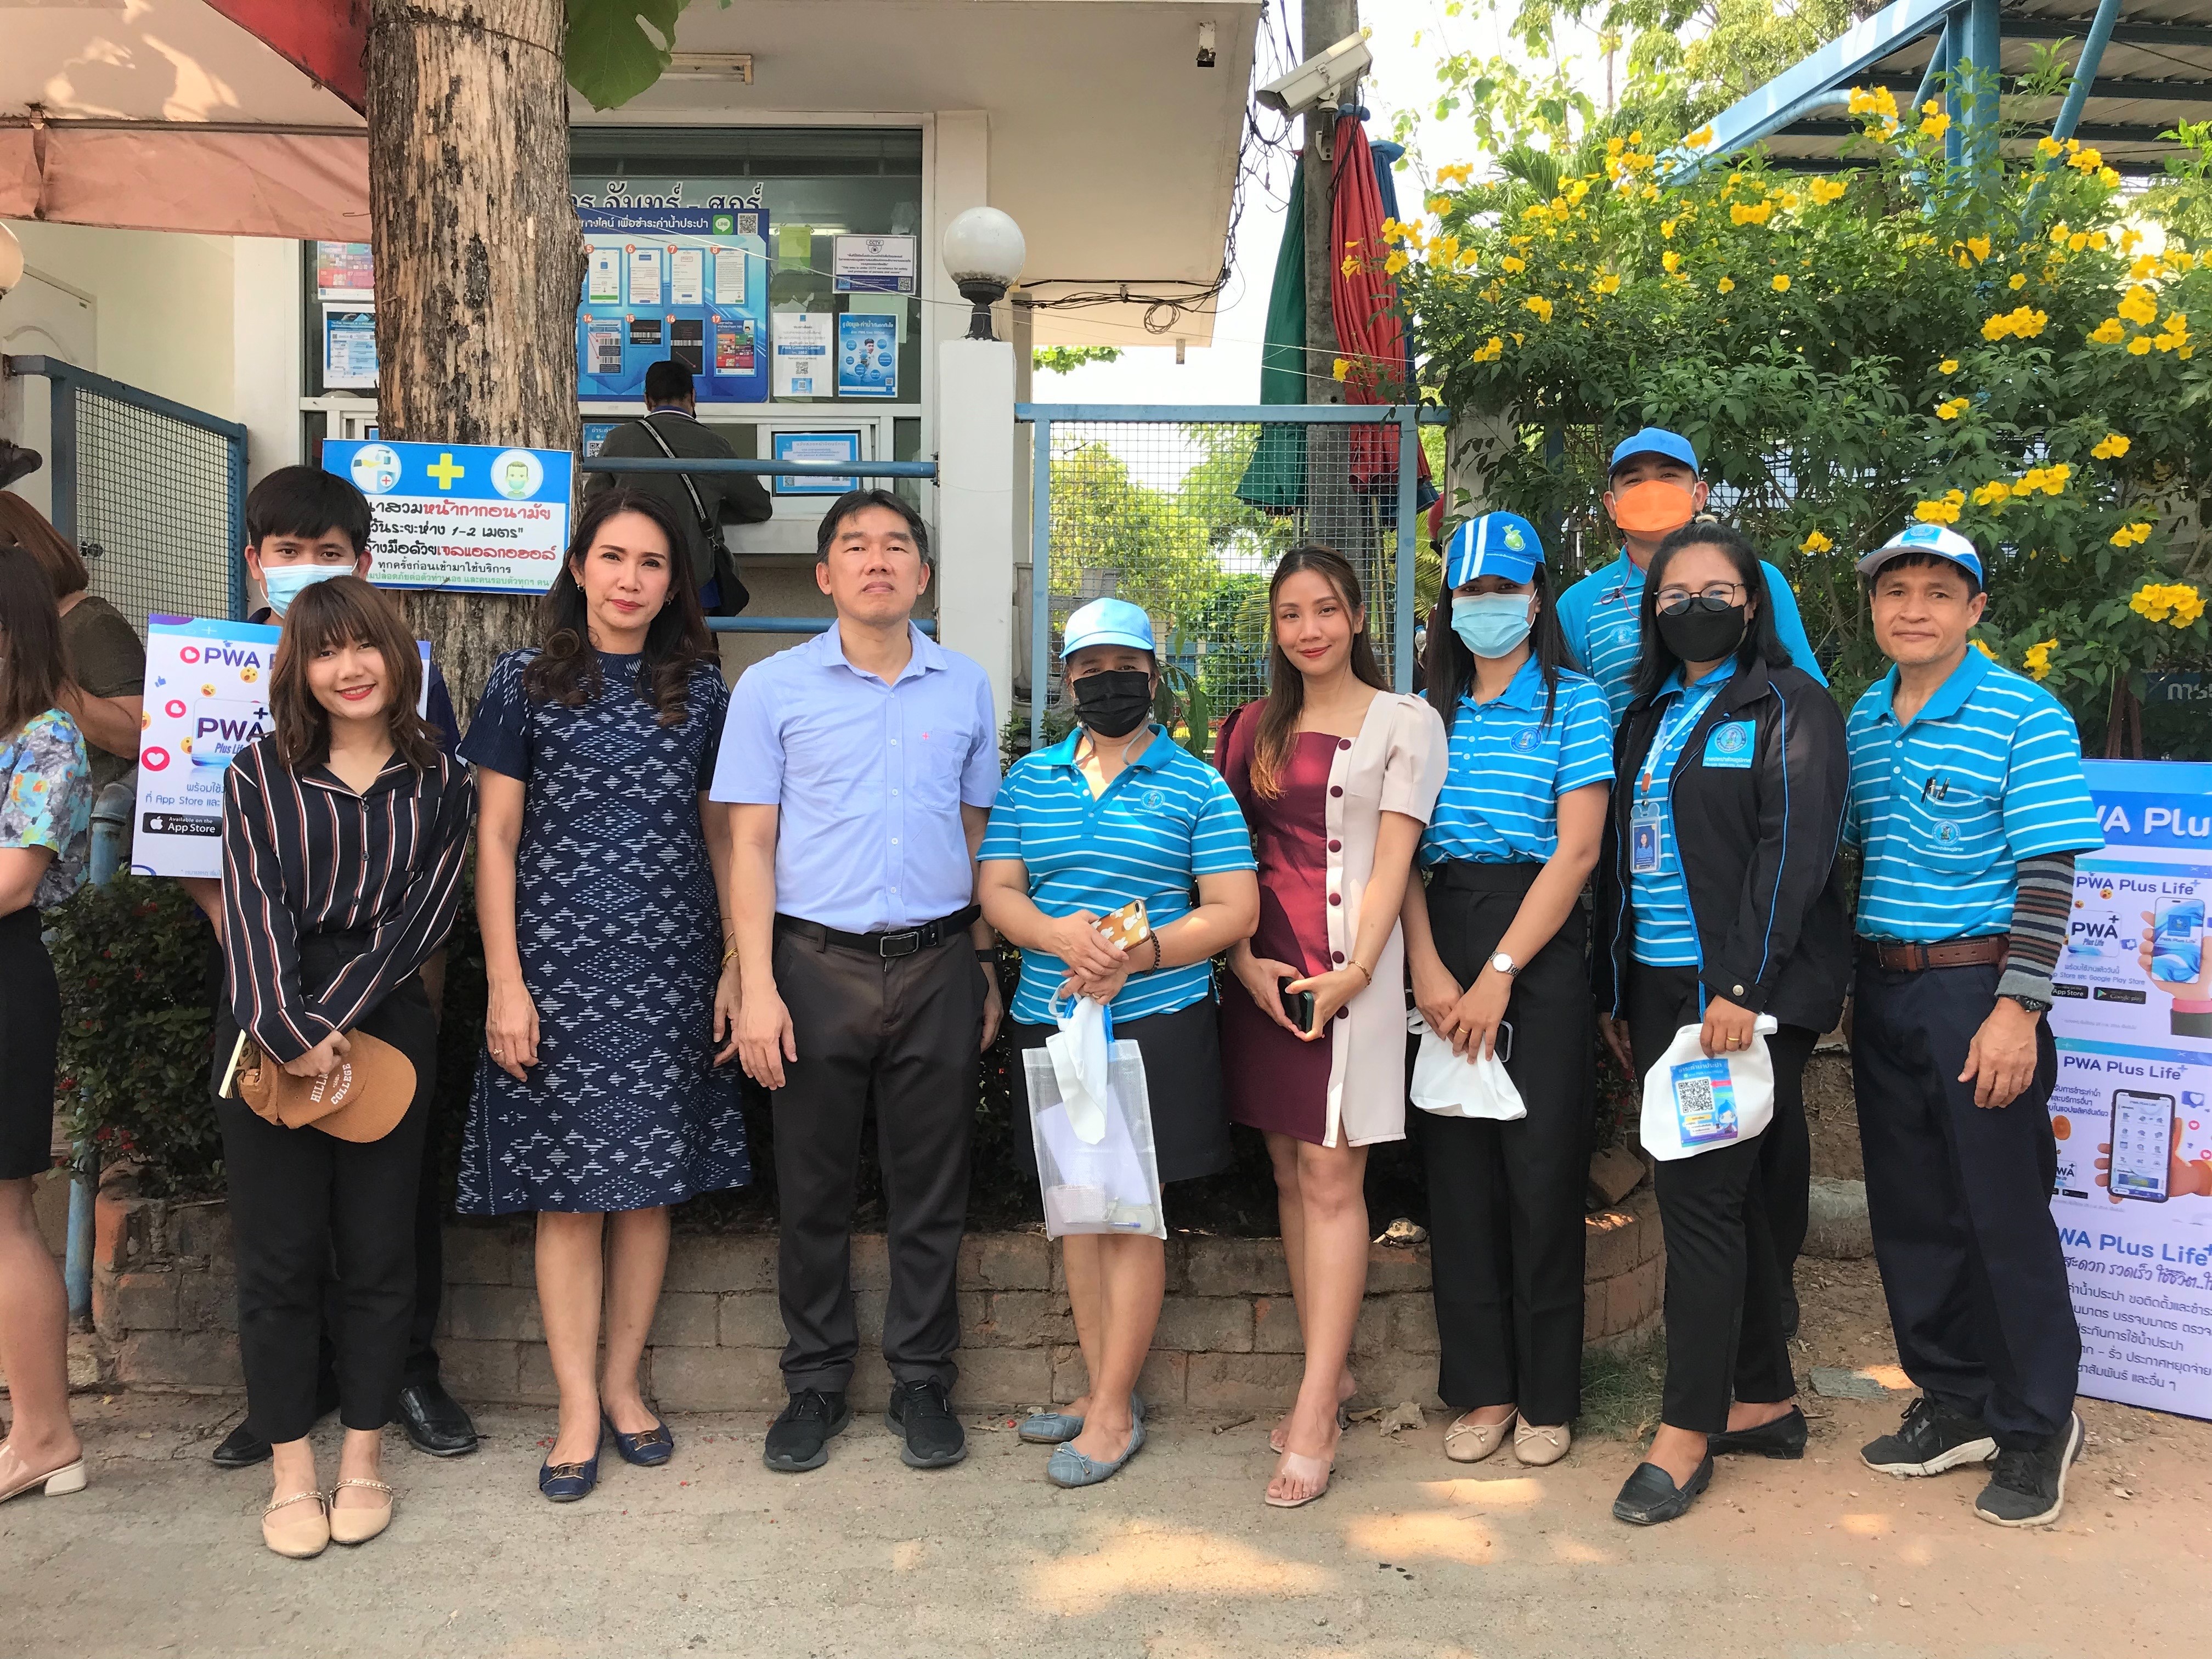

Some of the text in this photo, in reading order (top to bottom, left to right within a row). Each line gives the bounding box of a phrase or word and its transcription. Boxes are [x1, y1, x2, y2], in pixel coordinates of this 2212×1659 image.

[378, 556, 511, 574] ทุกครั้งก่อนเข้ามาใช้บริการ
[205, 647, 261, 668] PWA
[198, 717, 264, 742] PWA
[215, 742, 244, 754] Plus Lif
[156, 795, 175, 805] App
[179, 796, 204, 806] Store
[167, 823, 216, 833] App Store
[2076, 876, 2194, 895] PWA Plus Life
[2071, 922, 2118, 939] PWA
[2064, 1056, 2181, 1080] PWA Plus Life
[330, 1063, 352, 1105] COLLEGE
[2056, 1167, 2074, 1177] WA
[2100, 1234, 2154, 1258] Plus
[2162, 1243, 2208, 1266] Life
[2109, 1263, 2153, 1281] รวดเร็ว
